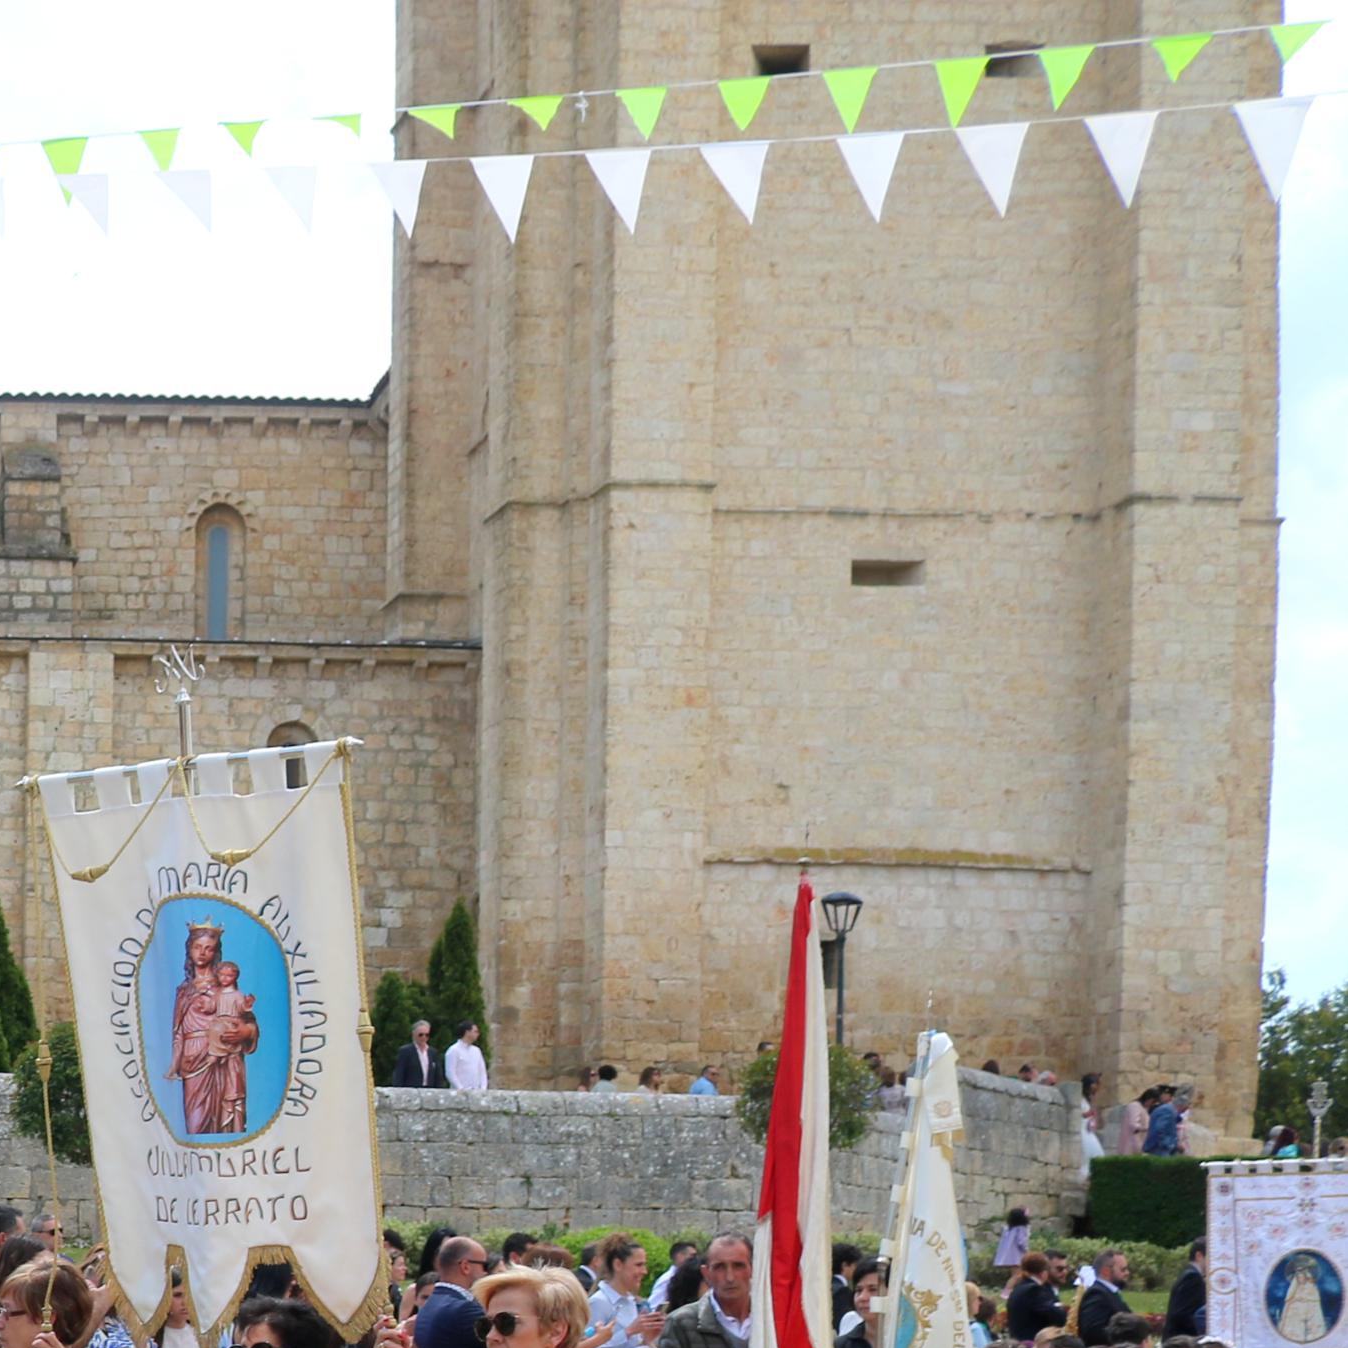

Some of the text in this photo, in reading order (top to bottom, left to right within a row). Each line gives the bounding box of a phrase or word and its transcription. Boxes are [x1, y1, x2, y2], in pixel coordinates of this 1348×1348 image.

[157, 861, 248, 898] MARIA
[258, 894, 328, 1117] AUXILIADORA
[155, 1195, 179, 1224] DE
[925, 1230, 948, 1258] DE
